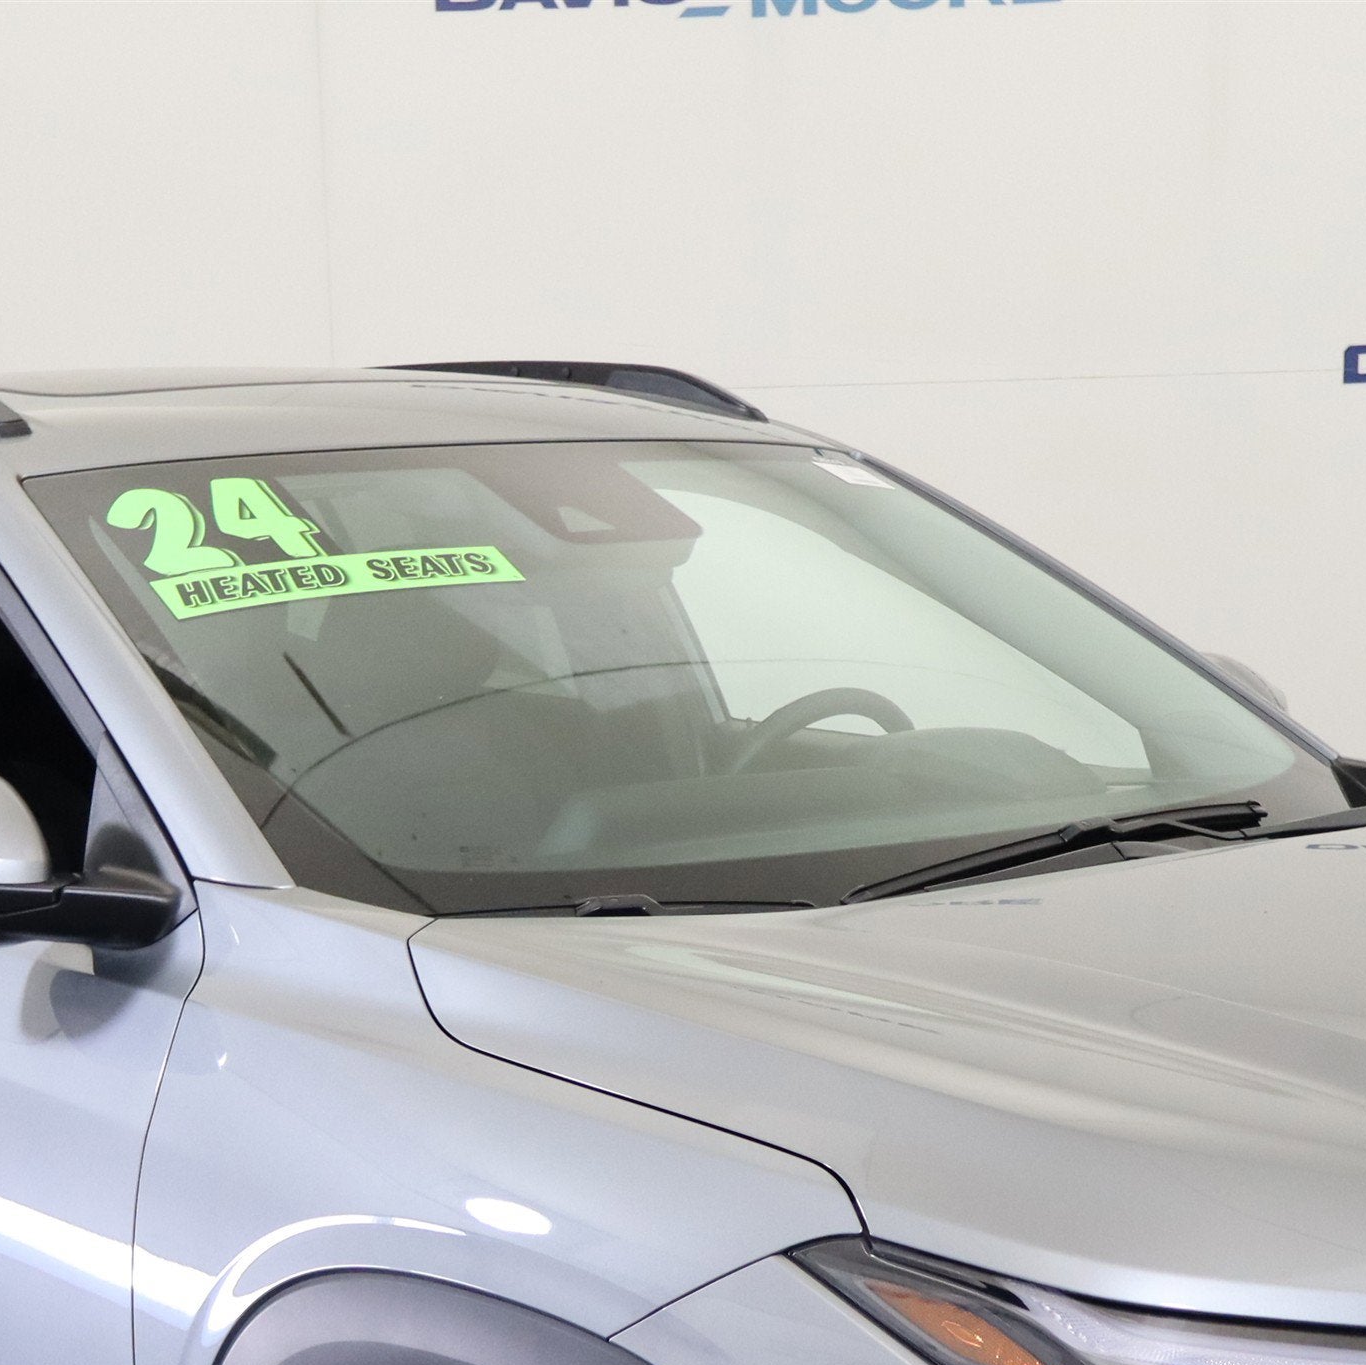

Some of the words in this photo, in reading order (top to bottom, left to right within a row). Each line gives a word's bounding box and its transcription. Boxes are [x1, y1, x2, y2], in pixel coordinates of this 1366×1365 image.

[107, 477, 321, 575] 24
[177, 562, 347, 609] HEATED
[366, 552, 498, 584] SEATS
